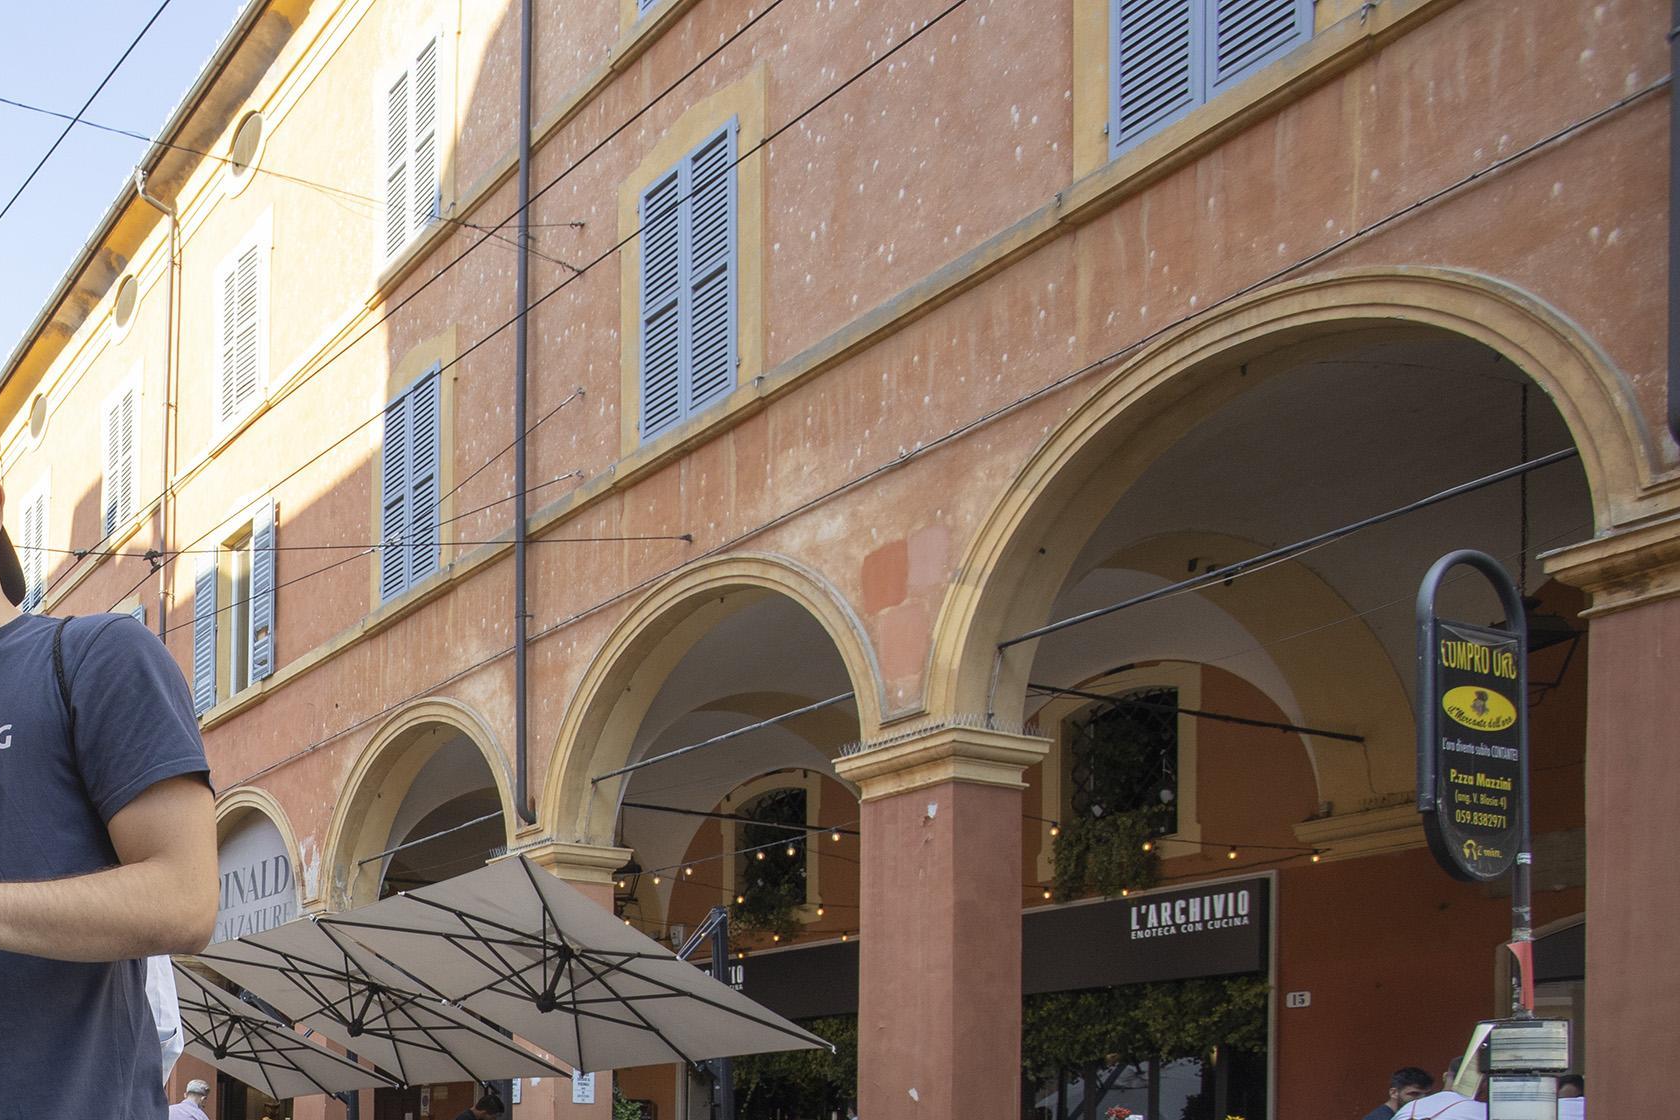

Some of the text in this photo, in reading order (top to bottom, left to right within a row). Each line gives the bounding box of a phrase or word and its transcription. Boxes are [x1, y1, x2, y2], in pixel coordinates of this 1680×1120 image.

[1450, 768, 1512, 791] P.zza Mazzini
[219, 855, 295, 910] INALD
[1130, 890, 1250, 930] L'ARCHIVIO
[1130, 916, 1250, 940] ENOTECA CON CUCINA
